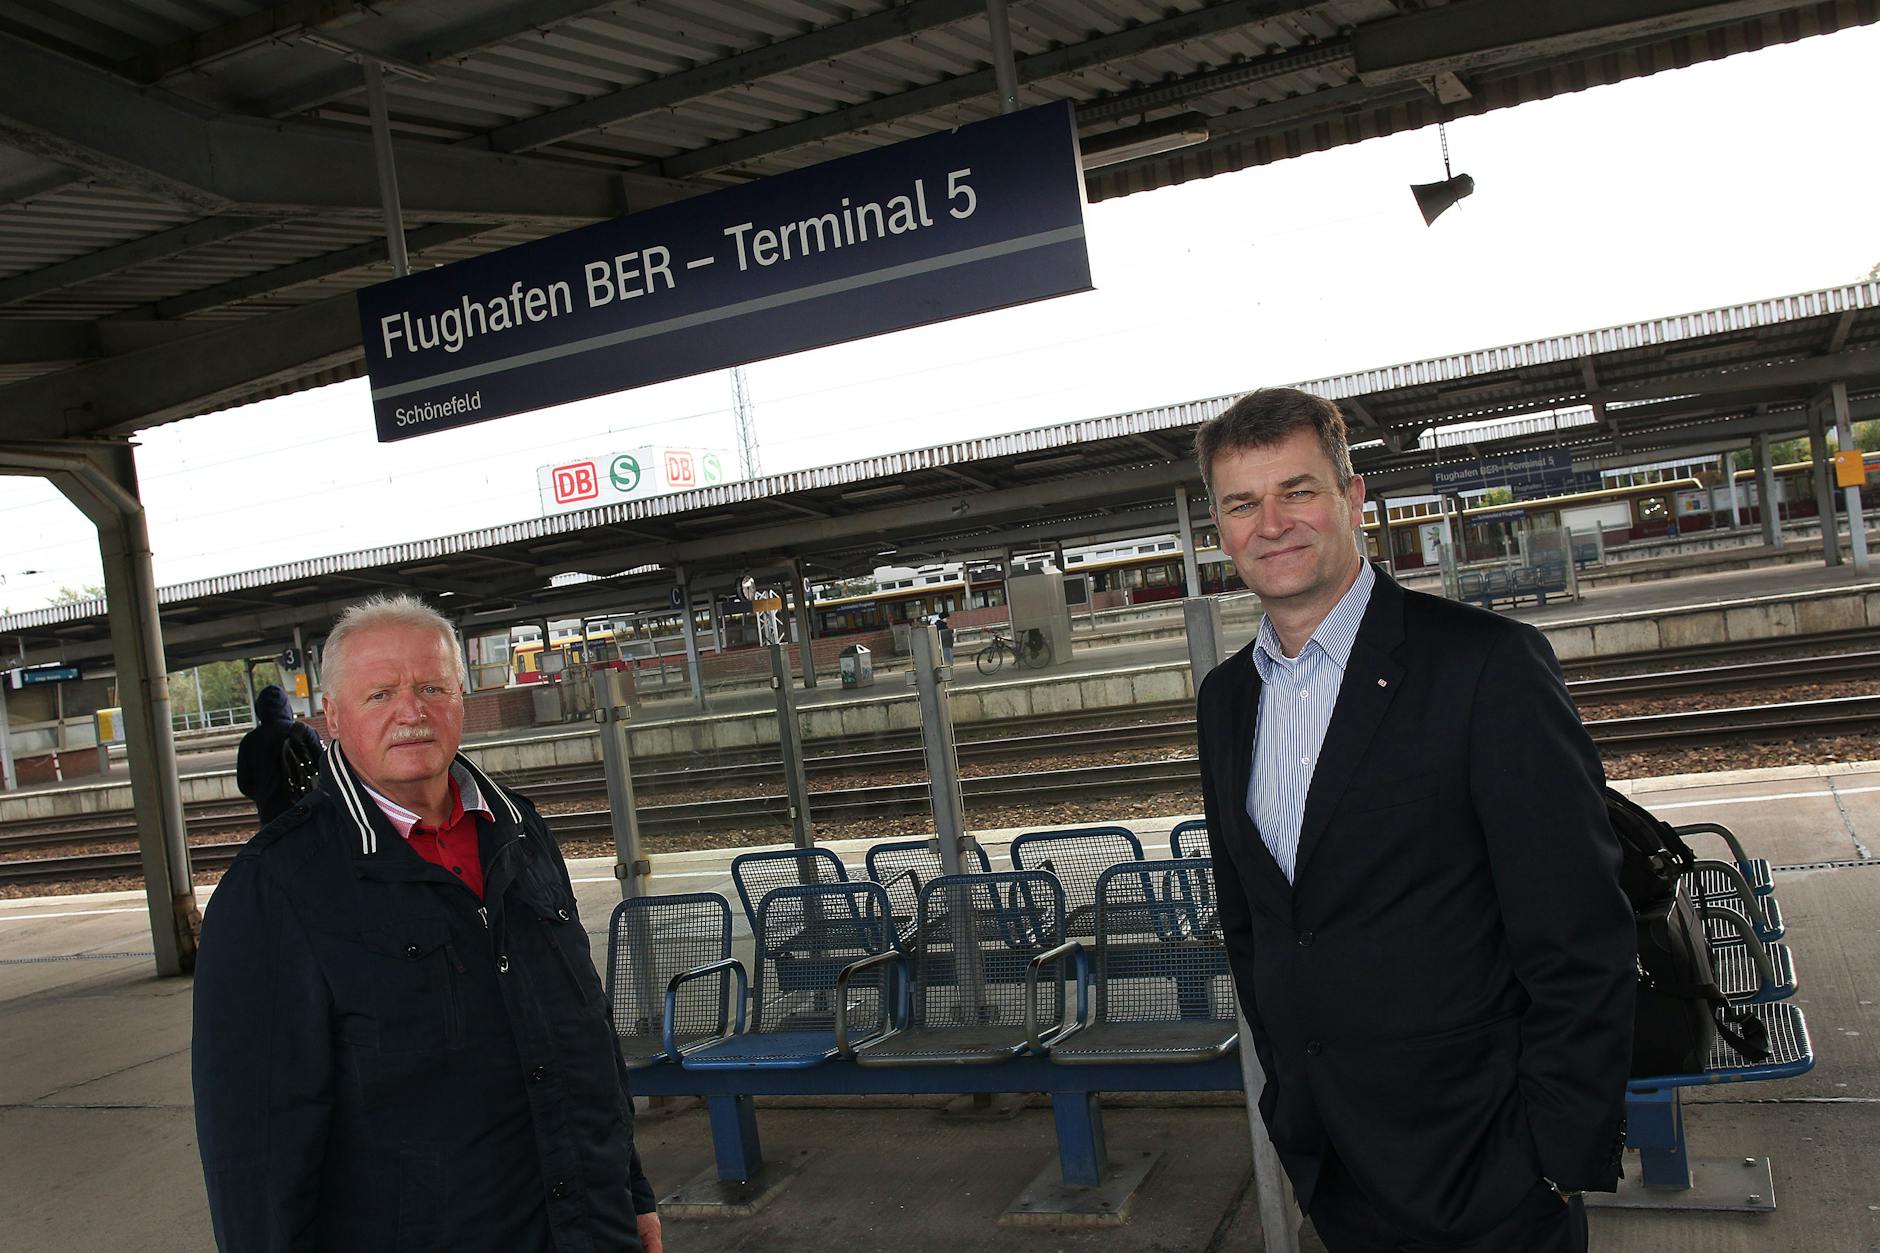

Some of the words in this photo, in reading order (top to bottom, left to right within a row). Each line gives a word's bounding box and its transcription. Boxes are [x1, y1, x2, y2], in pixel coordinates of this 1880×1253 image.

[381, 282, 573, 359] Flughafen
[584, 245, 676, 308] BER
[723, 180, 934, 271] Terminal
[948, 168, 978, 219] 5
[395, 391, 482, 427] Schönefeld
[557, 468, 594, 498] DB
[610, 455, 640, 492] S
[668, 456, 692, 481] DB
[1435, 468, 1478, 482] Flughafen
[1548, 456, 1555, 466] 5
[672, 588, 681, 605] C
[803, 577, 811, 592] C
[286, 649, 295, 664] 3
